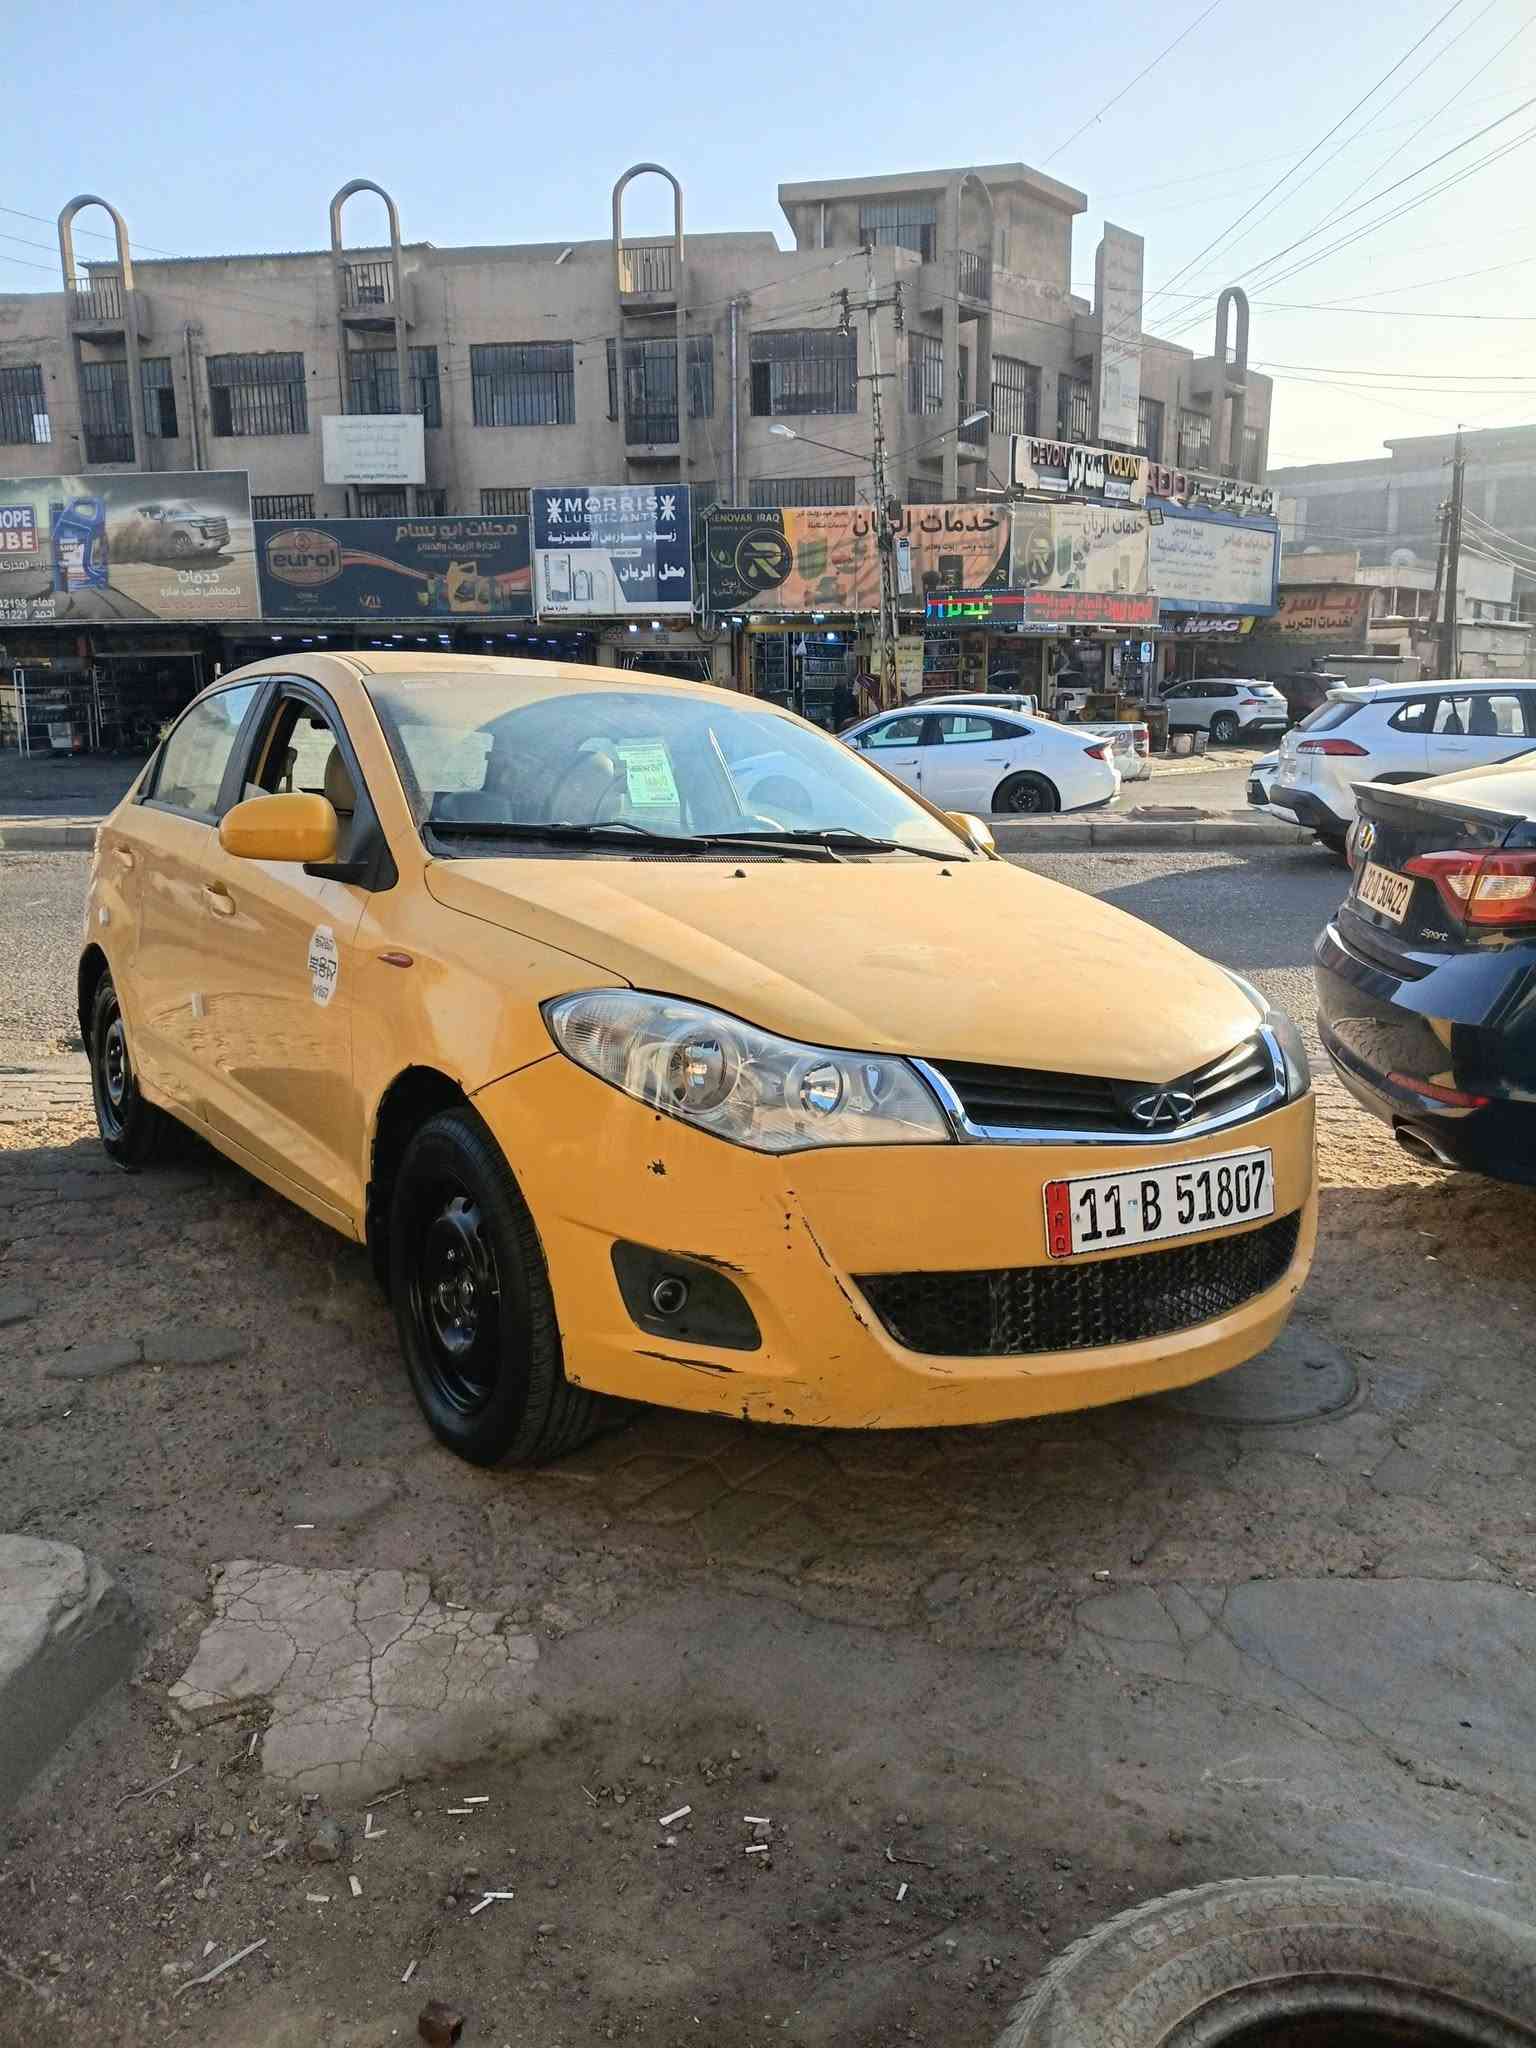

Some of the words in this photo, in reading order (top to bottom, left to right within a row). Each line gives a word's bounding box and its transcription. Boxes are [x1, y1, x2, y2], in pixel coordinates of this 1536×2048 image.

[1031, 440, 1068, 468] DEVON
[565, 495, 658, 513] MORRIS
[564, 512, 658, 523] LUBRICANTS
[757, 512, 780, 524] IRAQ
[920, 509, 1000, 532] خدمات
[395, 522, 438, 542] بسام
[440, 521, 463, 540] ابو
[465, 520, 518, 537] محلات
[272, 549, 336, 567] eurol
[619, 562, 655, 582] الريان
[658, 562, 686, 581] محل
[1079, 1184, 1126, 1242] 11
[1140, 1180, 1163, 1232] B
[1176, 1159, 1266, 1225] 51807
